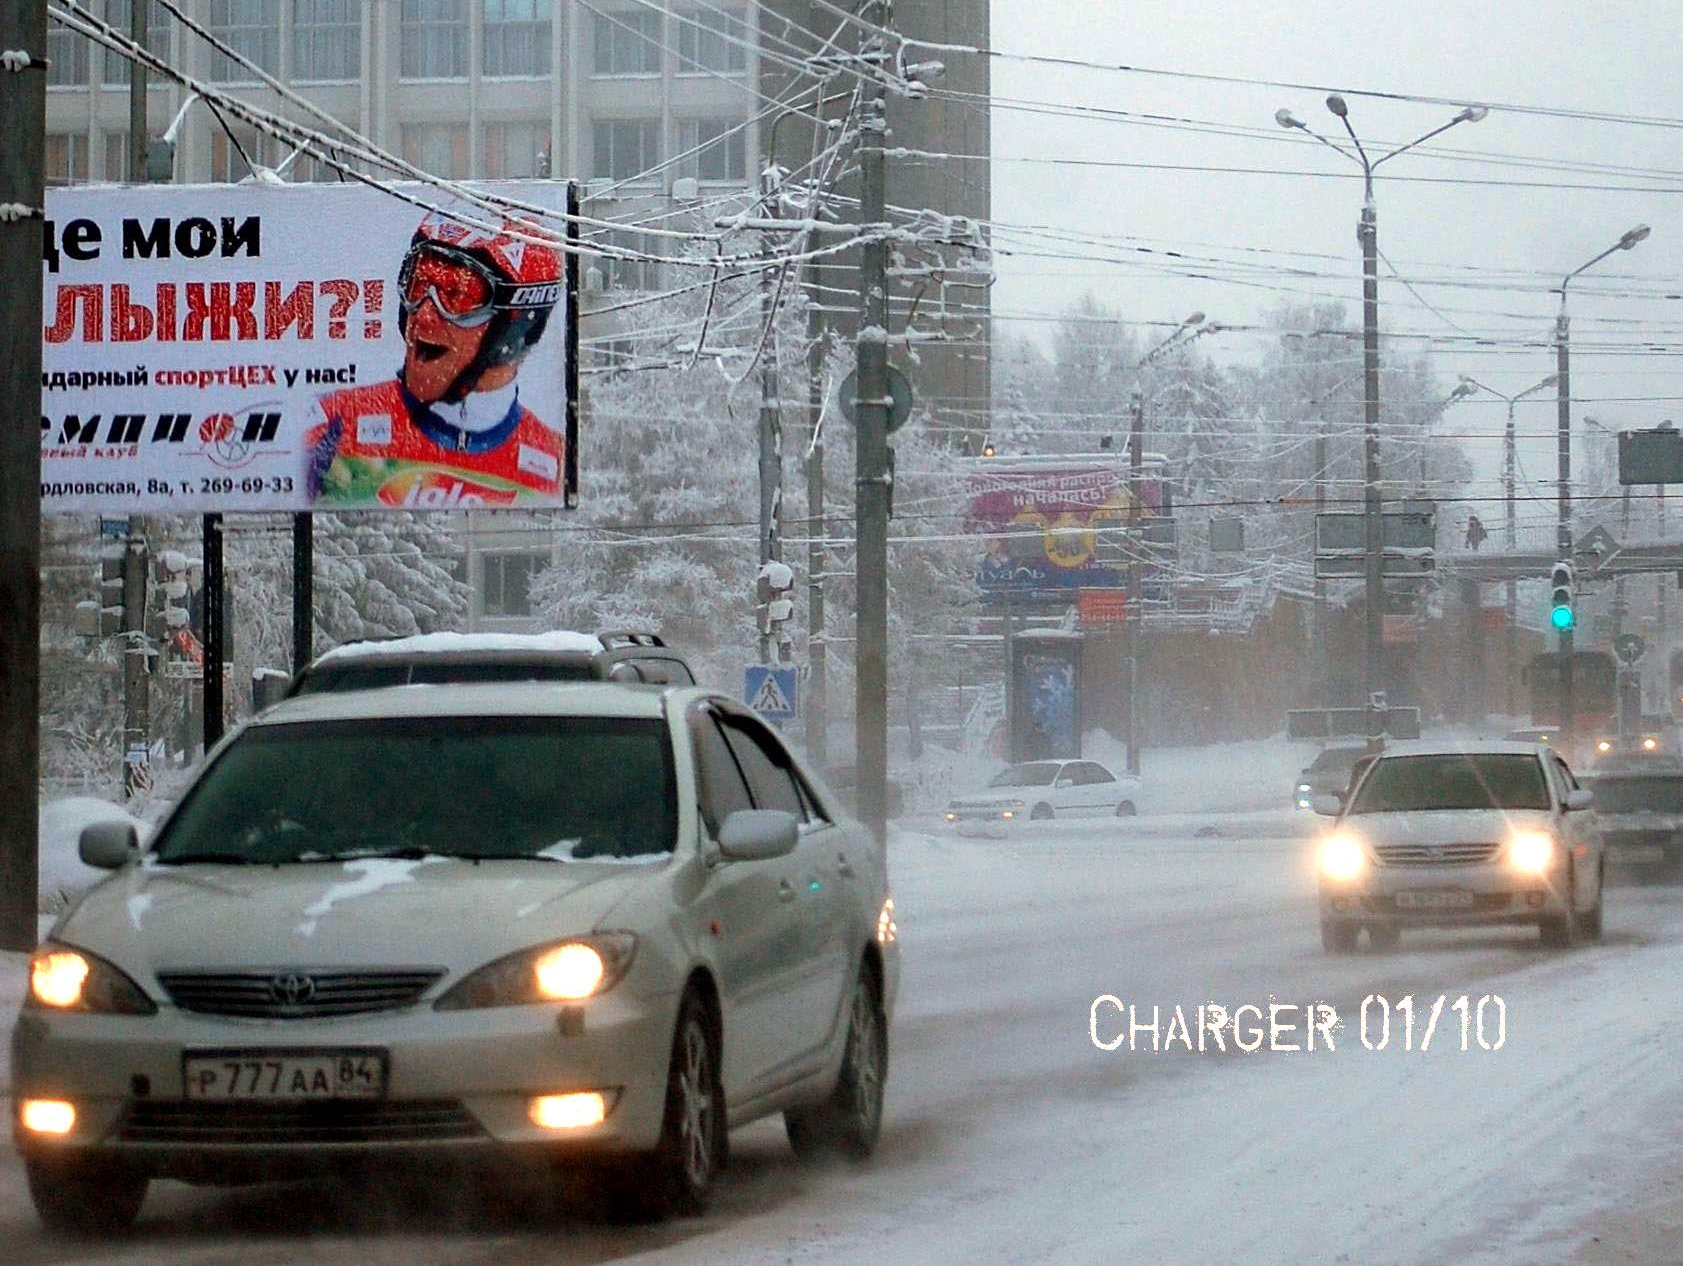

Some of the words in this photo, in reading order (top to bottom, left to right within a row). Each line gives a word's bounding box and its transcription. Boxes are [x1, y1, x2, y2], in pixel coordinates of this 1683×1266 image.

[123, 216, 260, 259] мои
[45, 279, 384, 344] ЛЫЖИ?!
[155, 365, 276, 389] спортЦЕХ
[283, 368, 299, 388] у
[305, 364, 356, 384] нас!
[147, 479, 174, 497] 8а,
[180, 481, 194, 494] т.
[200, 477, 293, 494] 269-69-33
